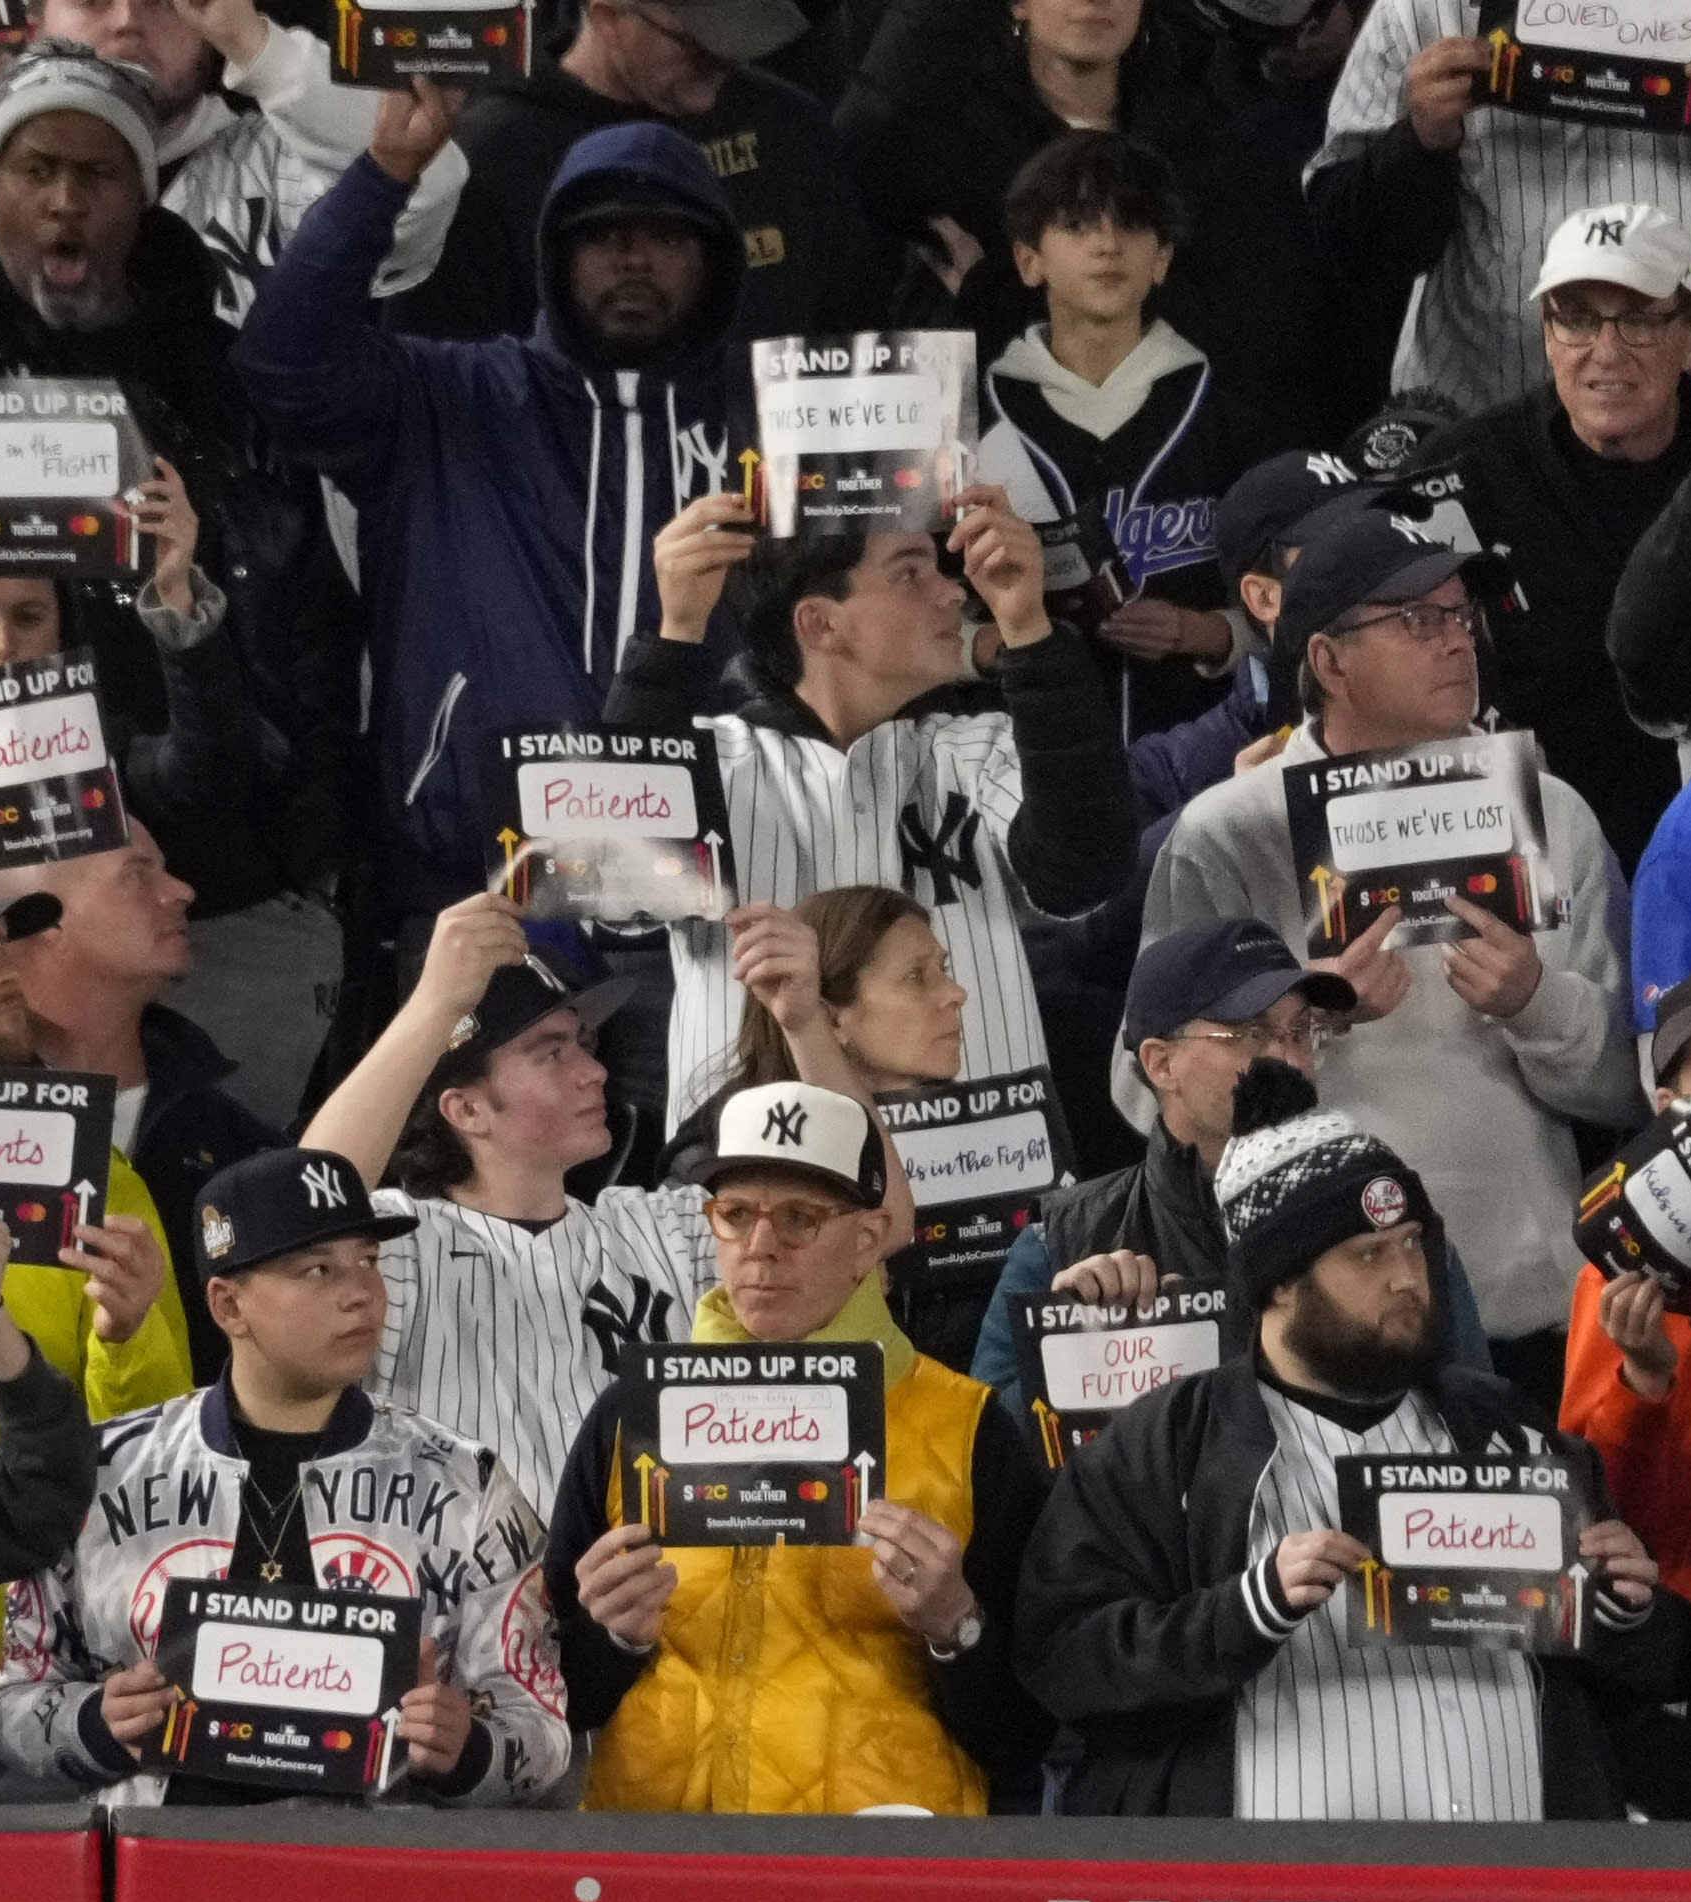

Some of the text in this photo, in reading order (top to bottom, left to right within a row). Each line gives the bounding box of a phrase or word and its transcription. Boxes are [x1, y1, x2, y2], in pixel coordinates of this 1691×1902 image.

[501, 733, 697, 760] I STAND UP FOR
[1309, 754, 1454, 795] I STAND UP
[543, 777, 671, 821] Patients
[1333, 806, 1505, 846] THOSE WE'VE LOST
[35, 1082, 88, 1107] FOR
[955, 1151, 994, 1175] the
[997, 1138, 1048, 1171] Fight
[646, 1355, 857, 1380] I STAND UP FOR
[684, 1402, 820, 1447] Patients
[738, 1489, 788, 1503] TOGETHER
[1362, 1465, 1569, 1490] I STAND UP FOR
[98, 1466, 460, 1547] NEW YORK
[706, 1515, 806, 1530] StandUpToCancer.org
[1404, 1507, 1535, 1550] Patients
[188, 1590, 396, 1632] I STAND UP FOR
[217, 1641, 352, 1692] Patients
[263, 1731, 311, 1748] TOGETHER
[226, 1752, 325, 1774] StandUpToCancer.org
